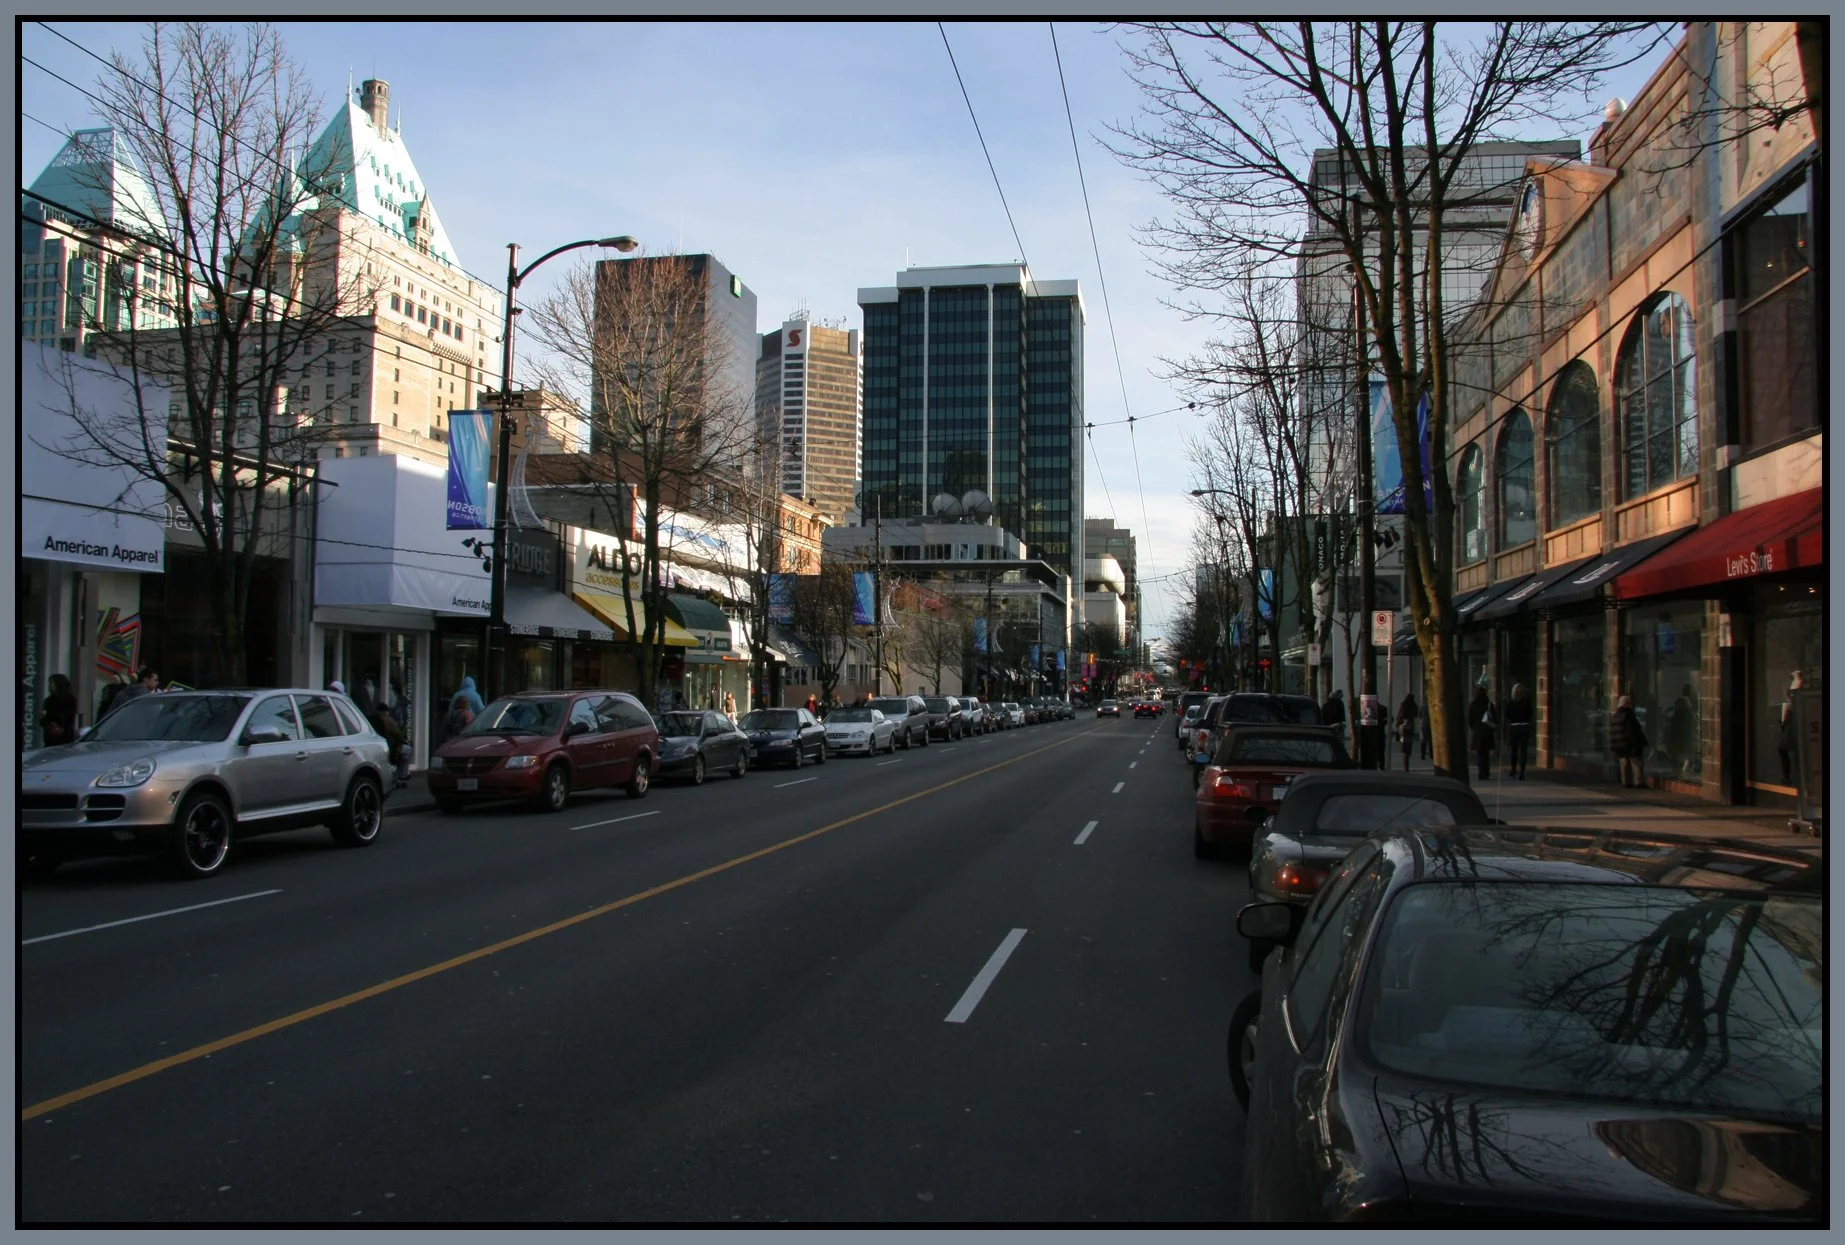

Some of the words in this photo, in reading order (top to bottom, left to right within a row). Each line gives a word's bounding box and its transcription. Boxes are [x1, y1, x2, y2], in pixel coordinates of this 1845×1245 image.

[44, 536, 108, 558] American
[112, 545, 160, 564] Apparel
[587, 544, 642, 577] ALDO
[1727, 555, 1749, 577] Levi's
[1750, 551, 1773, 573] Store
[452, 597, 480, 609] American
[24, 624, 37, 688] Apparel
